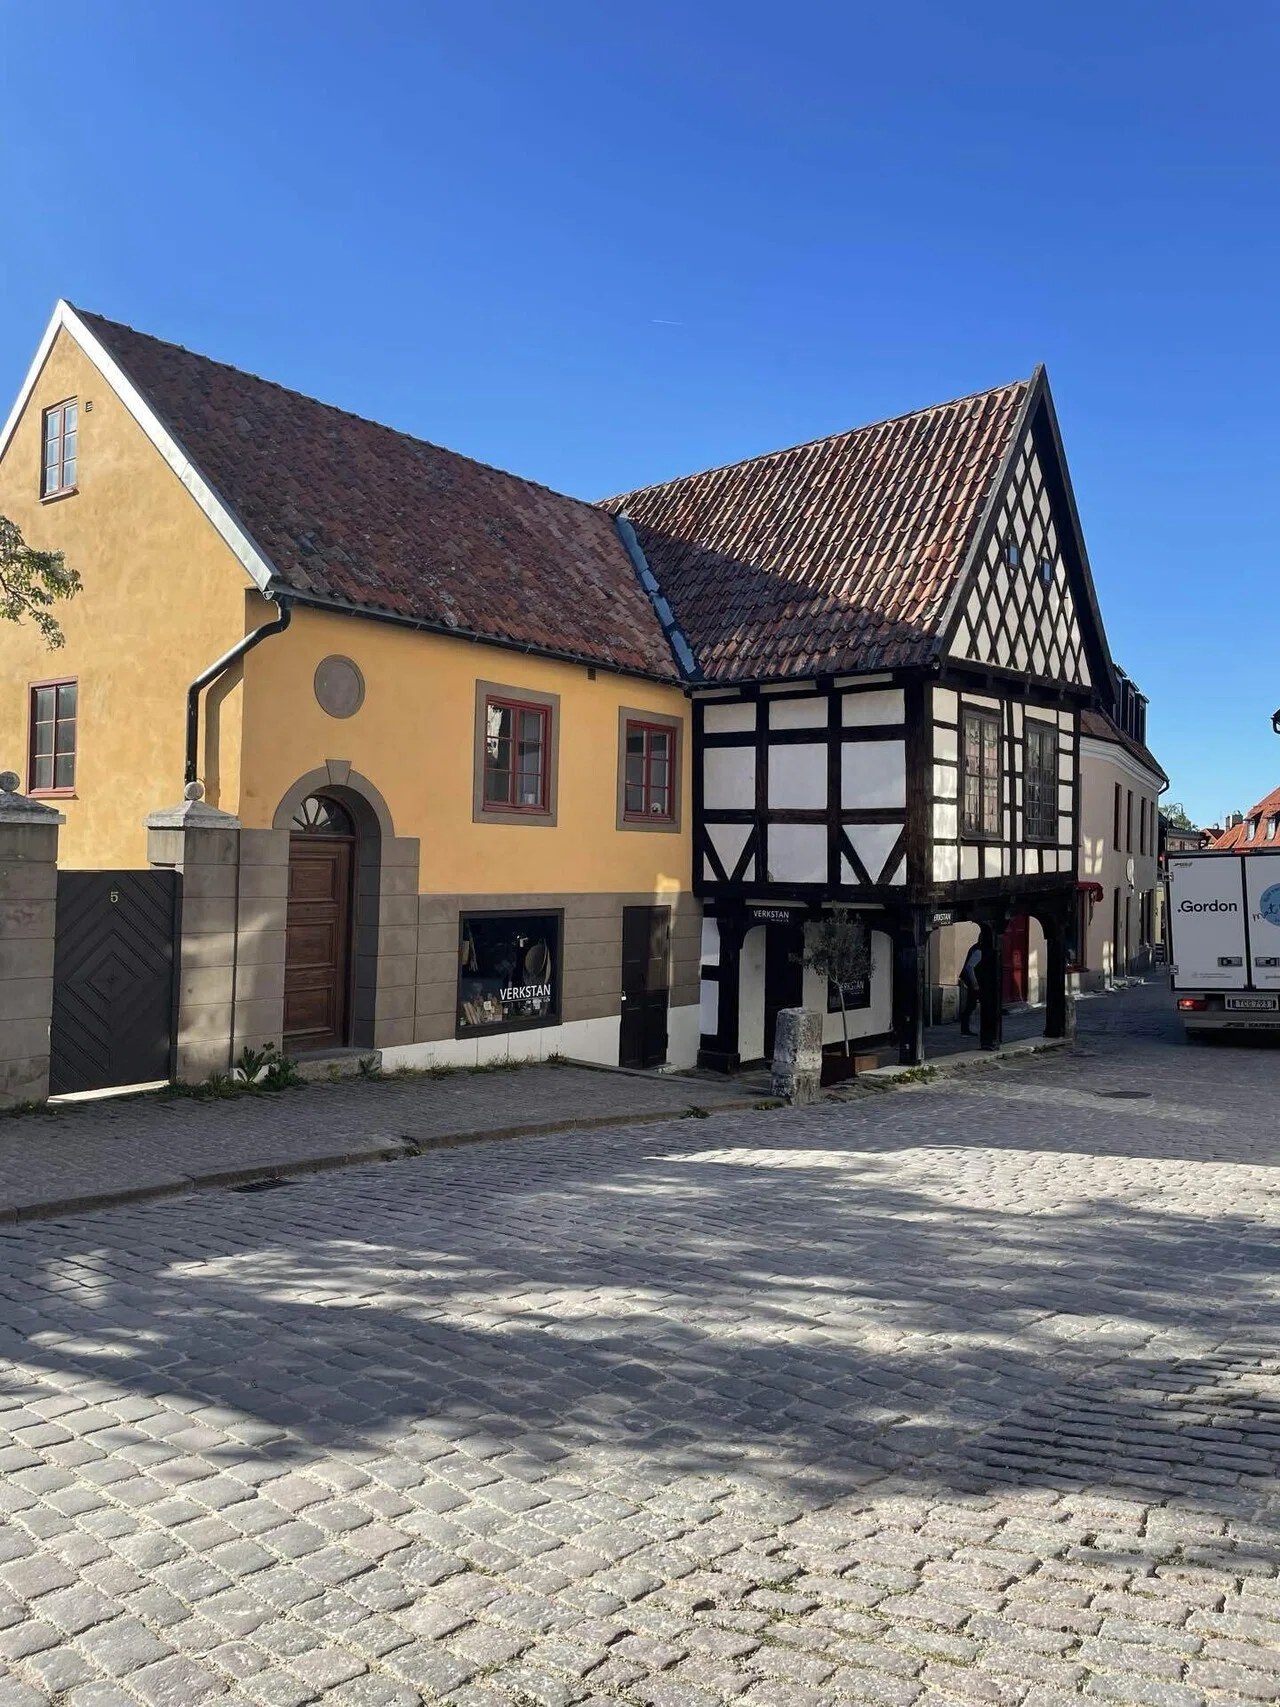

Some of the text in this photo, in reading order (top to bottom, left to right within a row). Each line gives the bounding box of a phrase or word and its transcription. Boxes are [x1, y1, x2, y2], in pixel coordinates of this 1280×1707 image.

[110, 891, 119, 902] 5
[1178, 900, 1238, 913] .Gordon
[753, 909, 790, 919] VERKSTAN
[933, 913, 952, 922] ERKSTAN
[499, 984, 551, 1000] VERKSTAN
